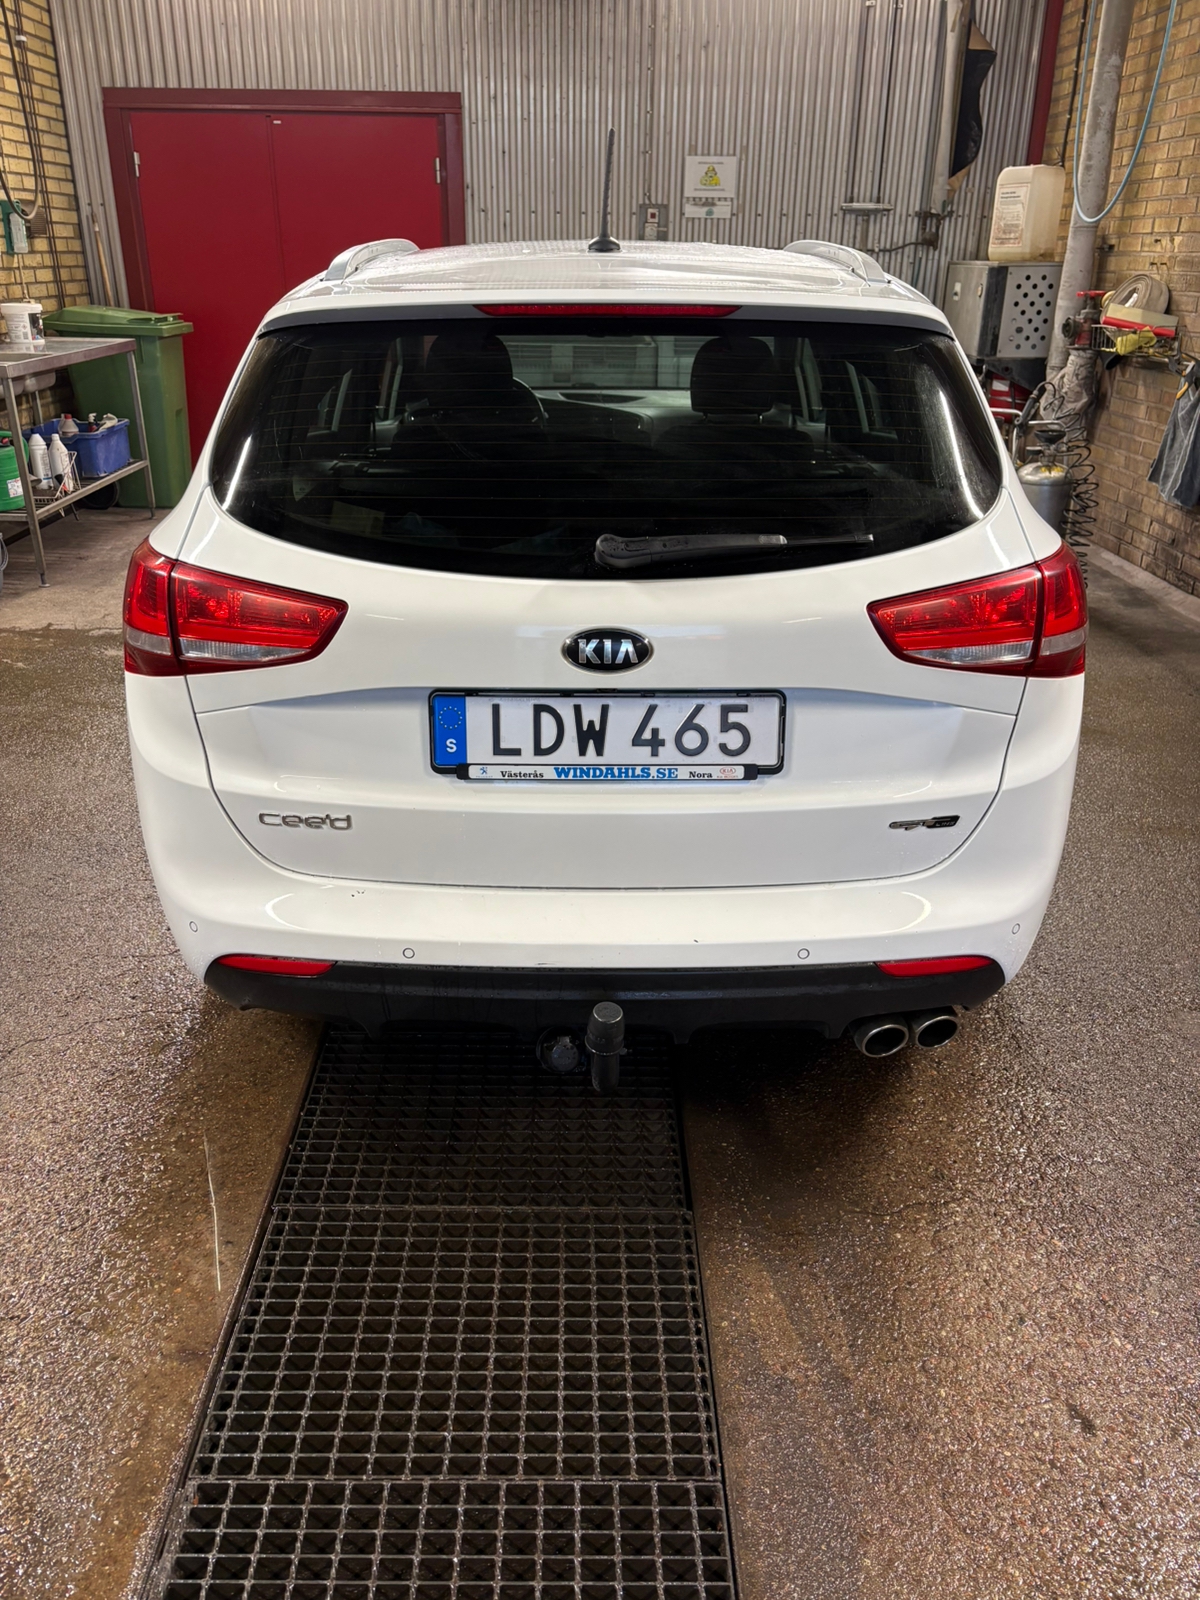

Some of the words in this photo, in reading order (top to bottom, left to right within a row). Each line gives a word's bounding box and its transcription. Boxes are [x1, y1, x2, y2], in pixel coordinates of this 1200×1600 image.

[578, 638, 638, 664] KIA
[446, 738, 457, 753] S
[491, 703, 610, 757] LDW
[631, 703, 751, 757] 465
[500, 770, 544, 779] Västerås
[553, 767, 678, 779] WINDAHLS.SE
[688, 771, 713, 779] Nora
